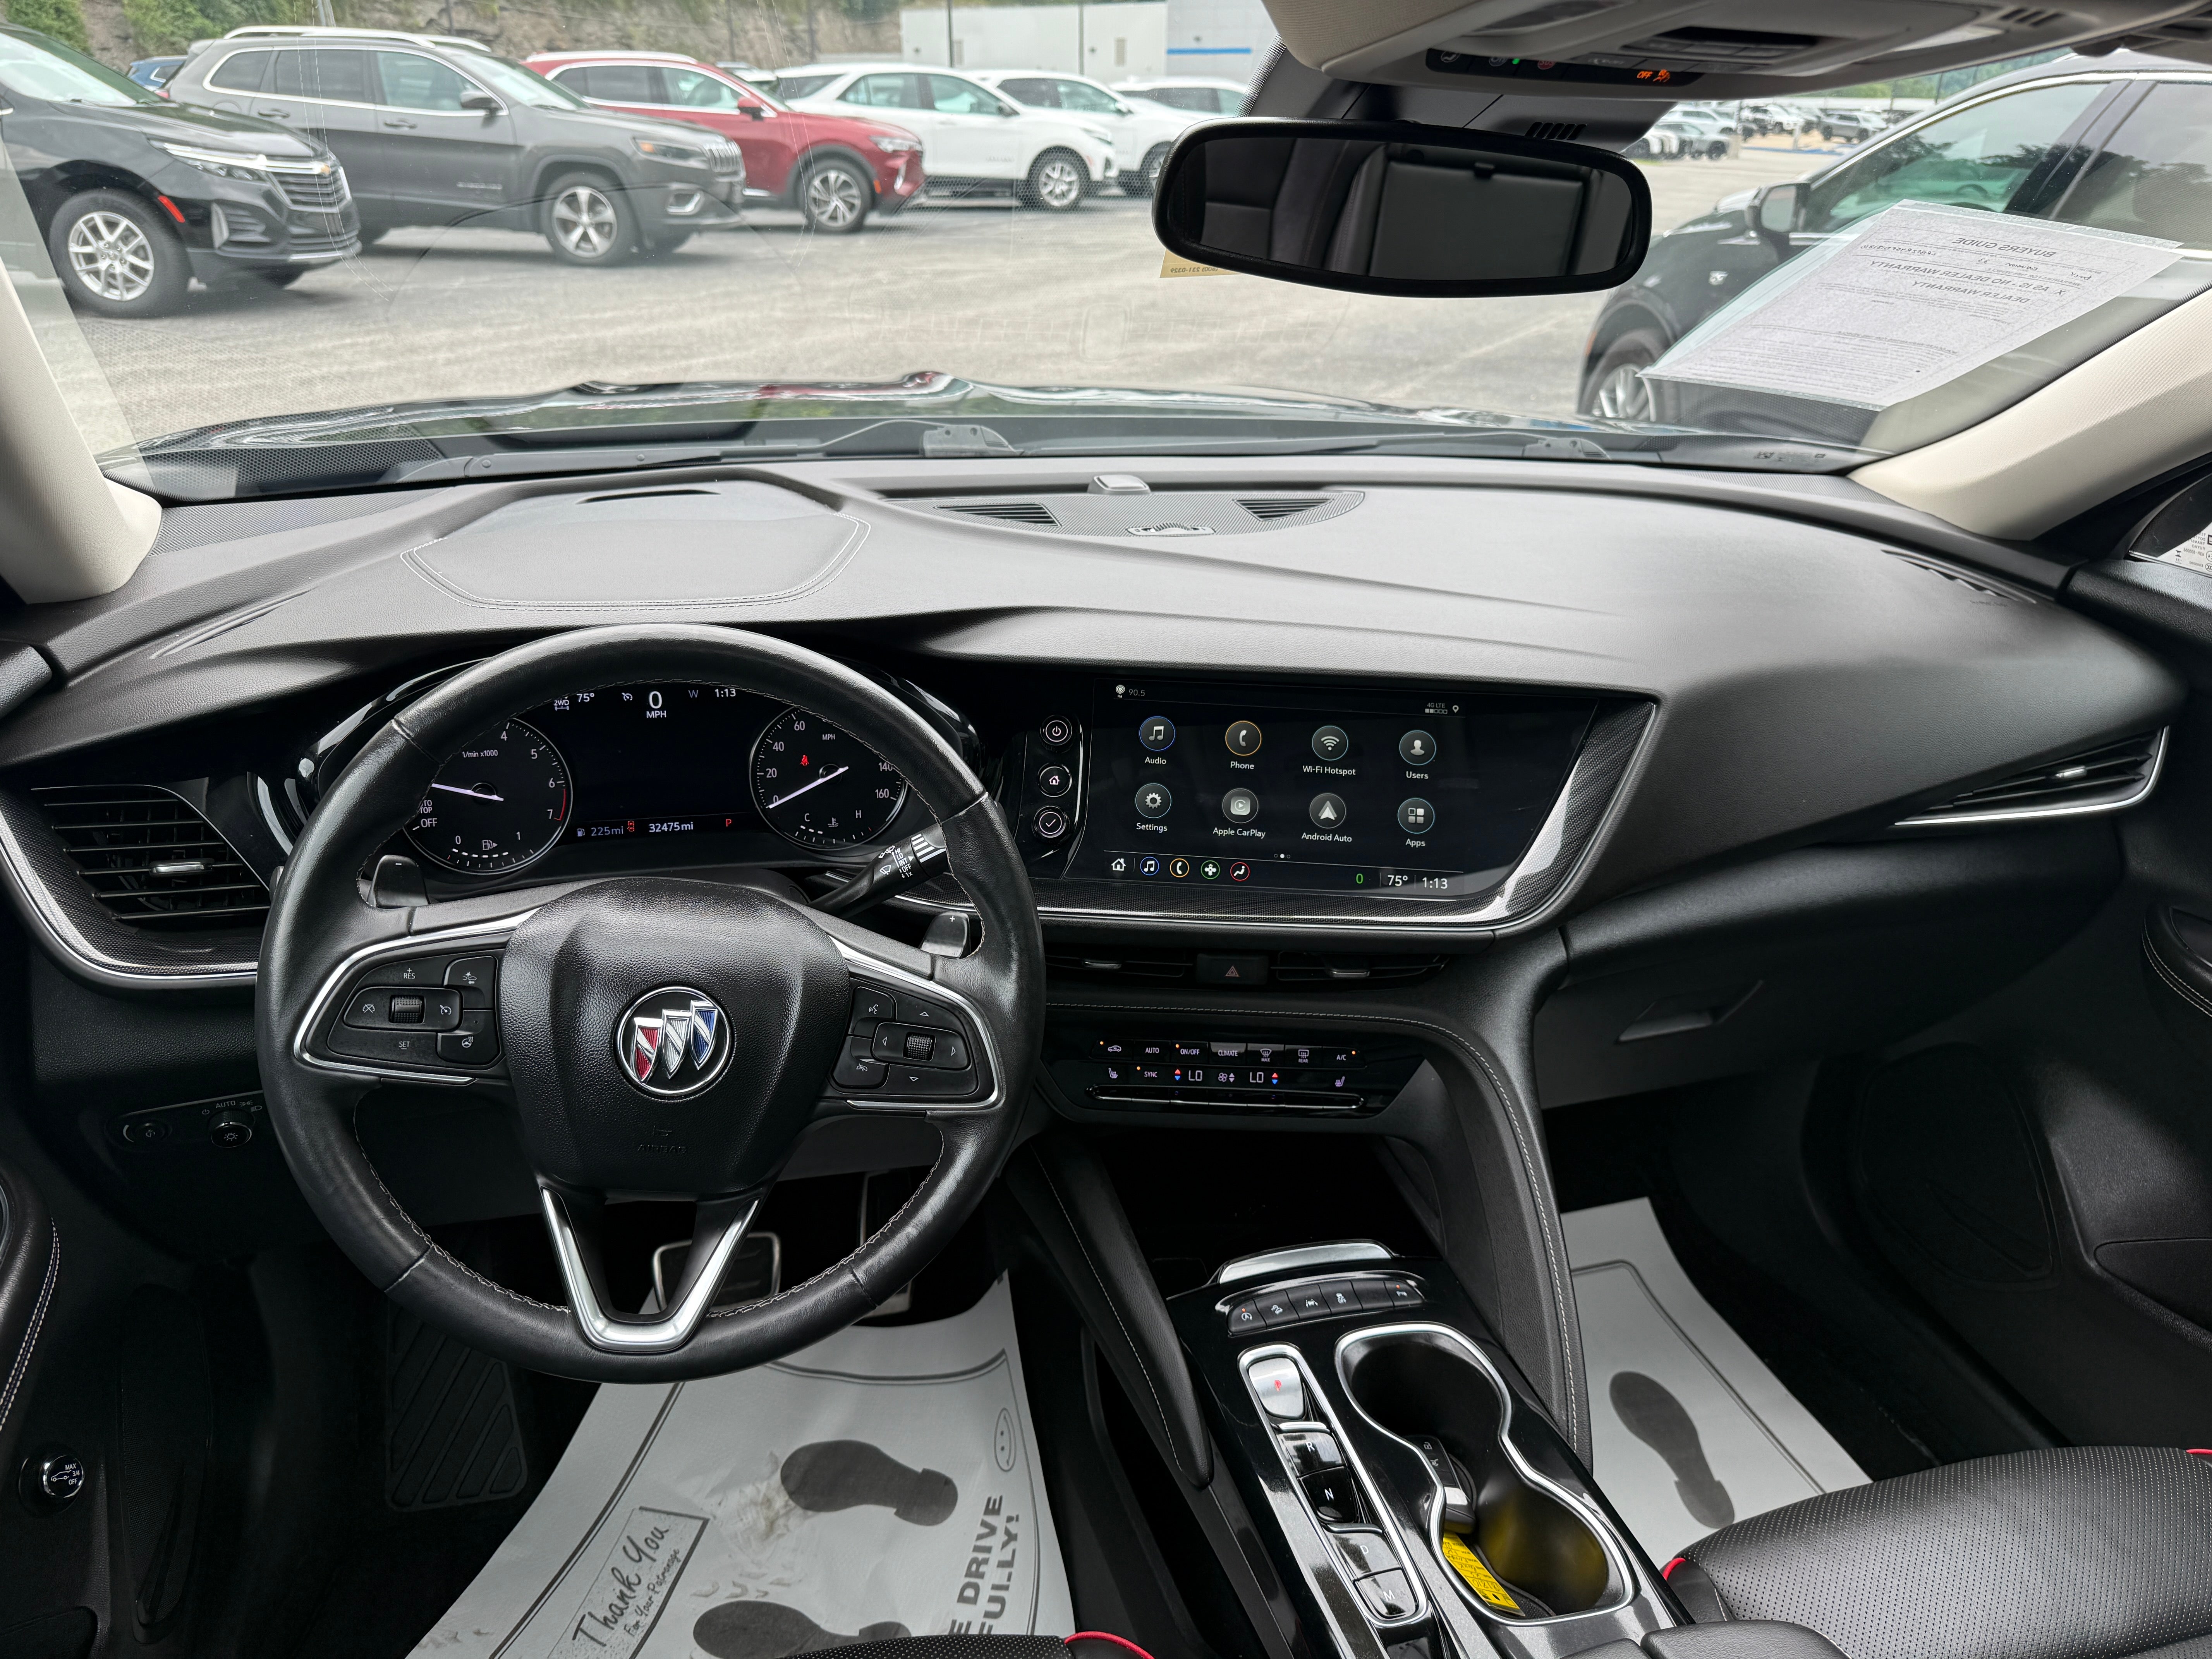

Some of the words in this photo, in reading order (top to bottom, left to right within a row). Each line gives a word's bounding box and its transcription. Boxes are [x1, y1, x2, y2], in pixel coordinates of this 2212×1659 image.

[1637, 71, 1653, 79] OFF
[577, 693, 595, 702] 75°
[689, 690, 699, 698] W
[714, 689, 736, 697] 1:13
[1128, 689, 1145, 697] 90.5
[648, 691, 662, 709] 0
[646, 710, 666, 718] MPH
[794, 721, 805, 731] 60
[501, 731, 508, 741] 4
[773, 742, 784, 752] 40
[531, 749, 538, 759] 5
[1144, 756, 1166, 765] Audio
[1230, 761, 1255, 770] Phone
[766, 768, 777, 778] 20
[1303, 765, 1322, 773] Wi-Fi
[1324, 766, 1356, 776] Hotspot
[1406, 771, 1429, 779] Users
[549, 778, 555, 788] 6
[875, 788, 889, 799] 160
[547, 809, 553, 819] 7
[804, 813, 810, 822] C
[855, 810, 862, 818] H
[421, 818, 438, 828] OFF
[725, 818, 732, 827] P
[1136, 823, 1168, 833] Settings
[1213, 827, 1235, 836] Apple
[1237, 829, 1266, 839] CarPlay
[455, 835, 461, 845] 0
[516, 831, 521, 840] 1
[1302, 832, 1332, 841] Android
[1334, 834, 1352, 842] Auto
[1405, 838, 1425, 848] Apps
[898, 857, 908, 866] INT
[902, 863, 911, 872] OFF
[1356, 873, 1364, 884] 0
[1388, 875, 1408, 886] 75°
[1422, 877, 1448, 889] 1:13
[1188, 1070, 1202, 1081] LO
[1250, 1072, 1264, 1083] LO
[216, 1100, 236, 1108] AUTO
[1305, 1441, 1315, 1453] R
[1324, 1487, 1334, 1501] N
[957, 1495, 1003, 1606] DRIVE
[1360, 1545, 1369, 1555] D
[572, 1566, 642, 1647] Thank
[623, 1526, 670, 1563] You
[635, 1595, 654, 1617] Your
[647, 1548, 682, 1595] Patronage
[1382, 1589, 1395, 1601] M
